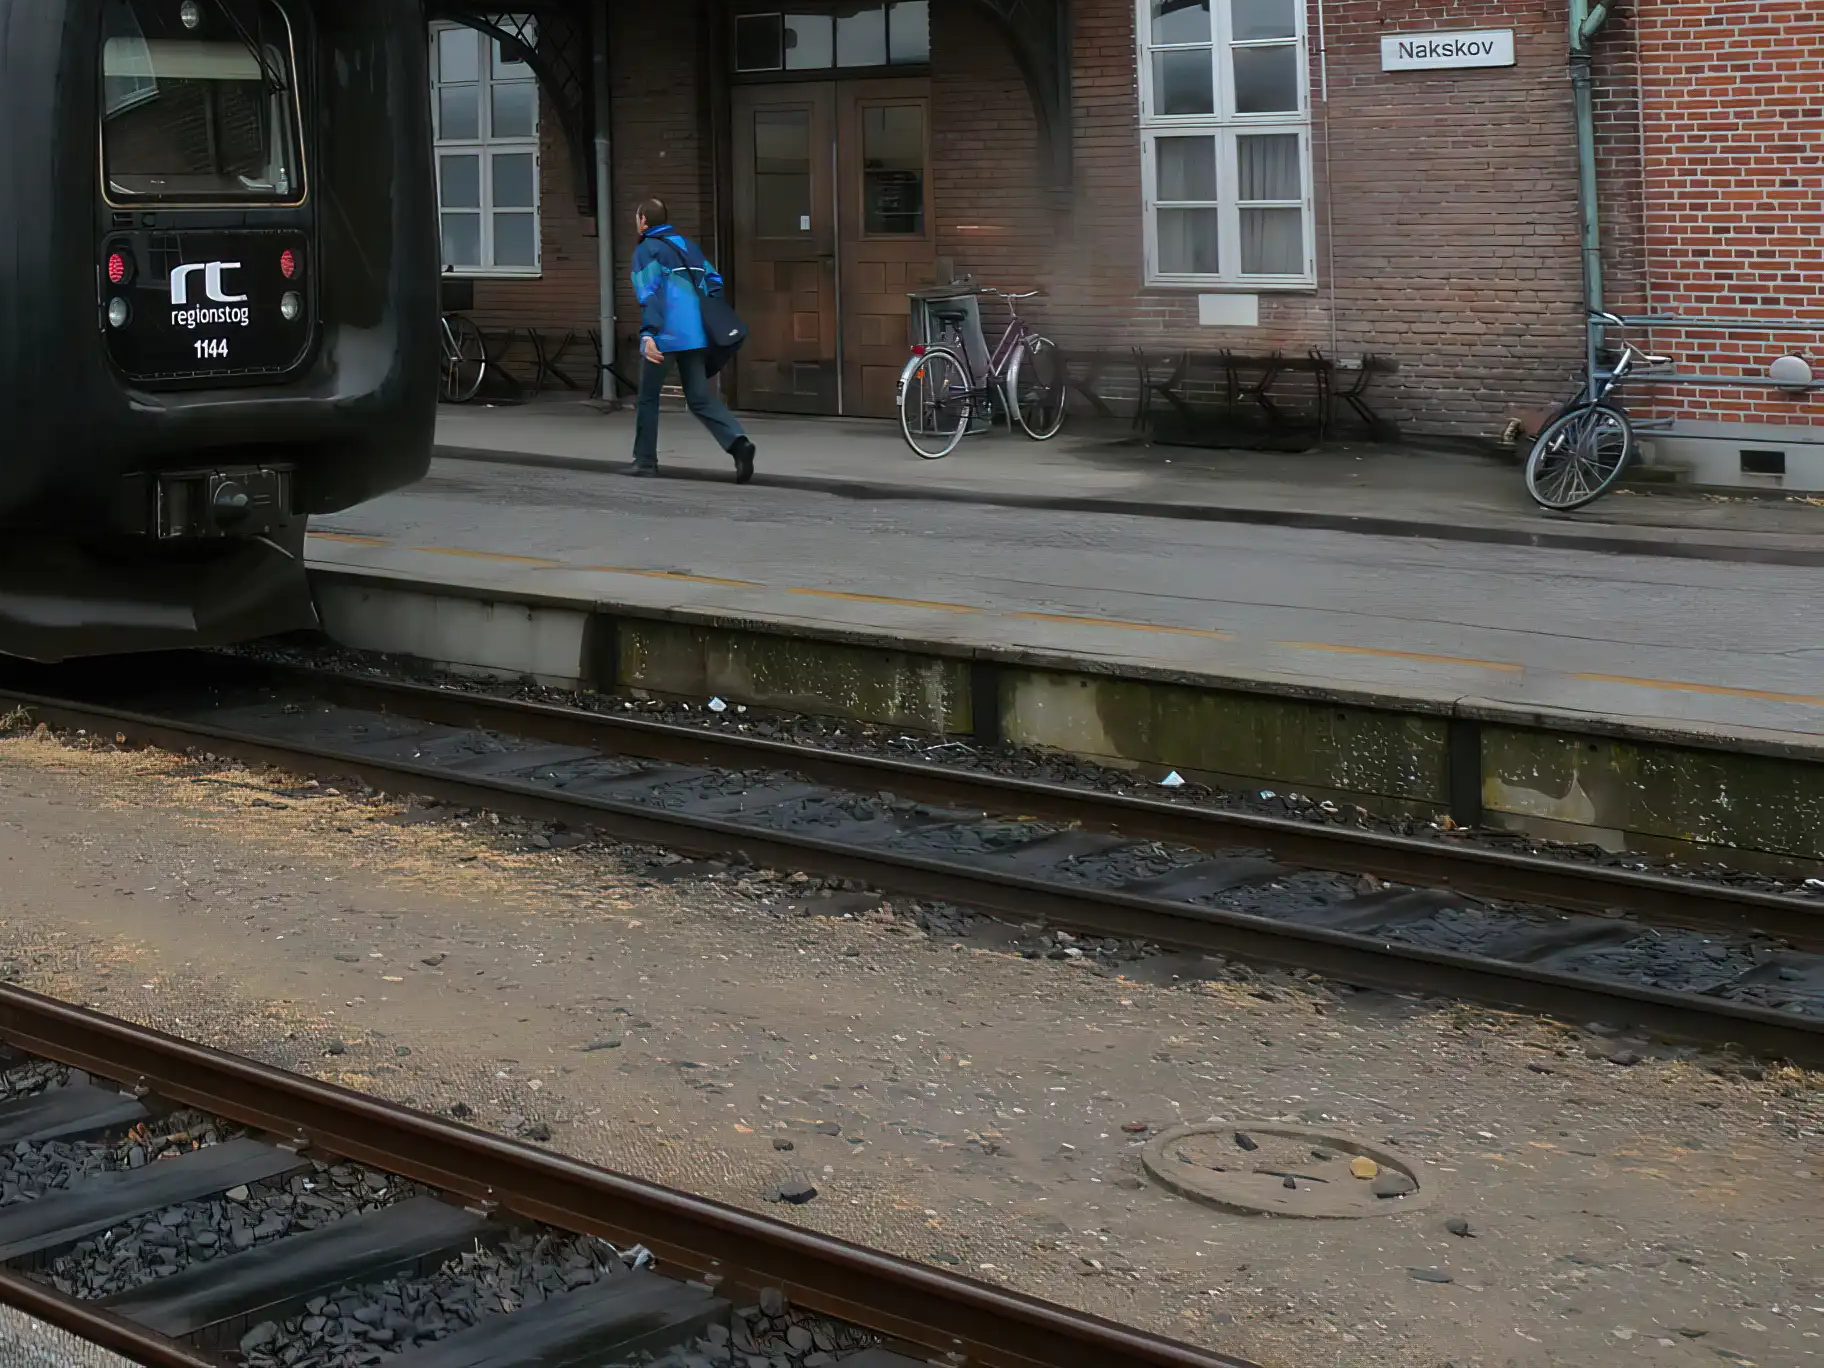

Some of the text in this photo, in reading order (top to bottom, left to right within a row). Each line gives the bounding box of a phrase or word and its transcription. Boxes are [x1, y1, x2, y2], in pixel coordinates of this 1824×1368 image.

[1398, 39, 1494, 59] Nakskov
[171, 304, 249, 329] regionstog
[194, 338, 229, 359] 1144
